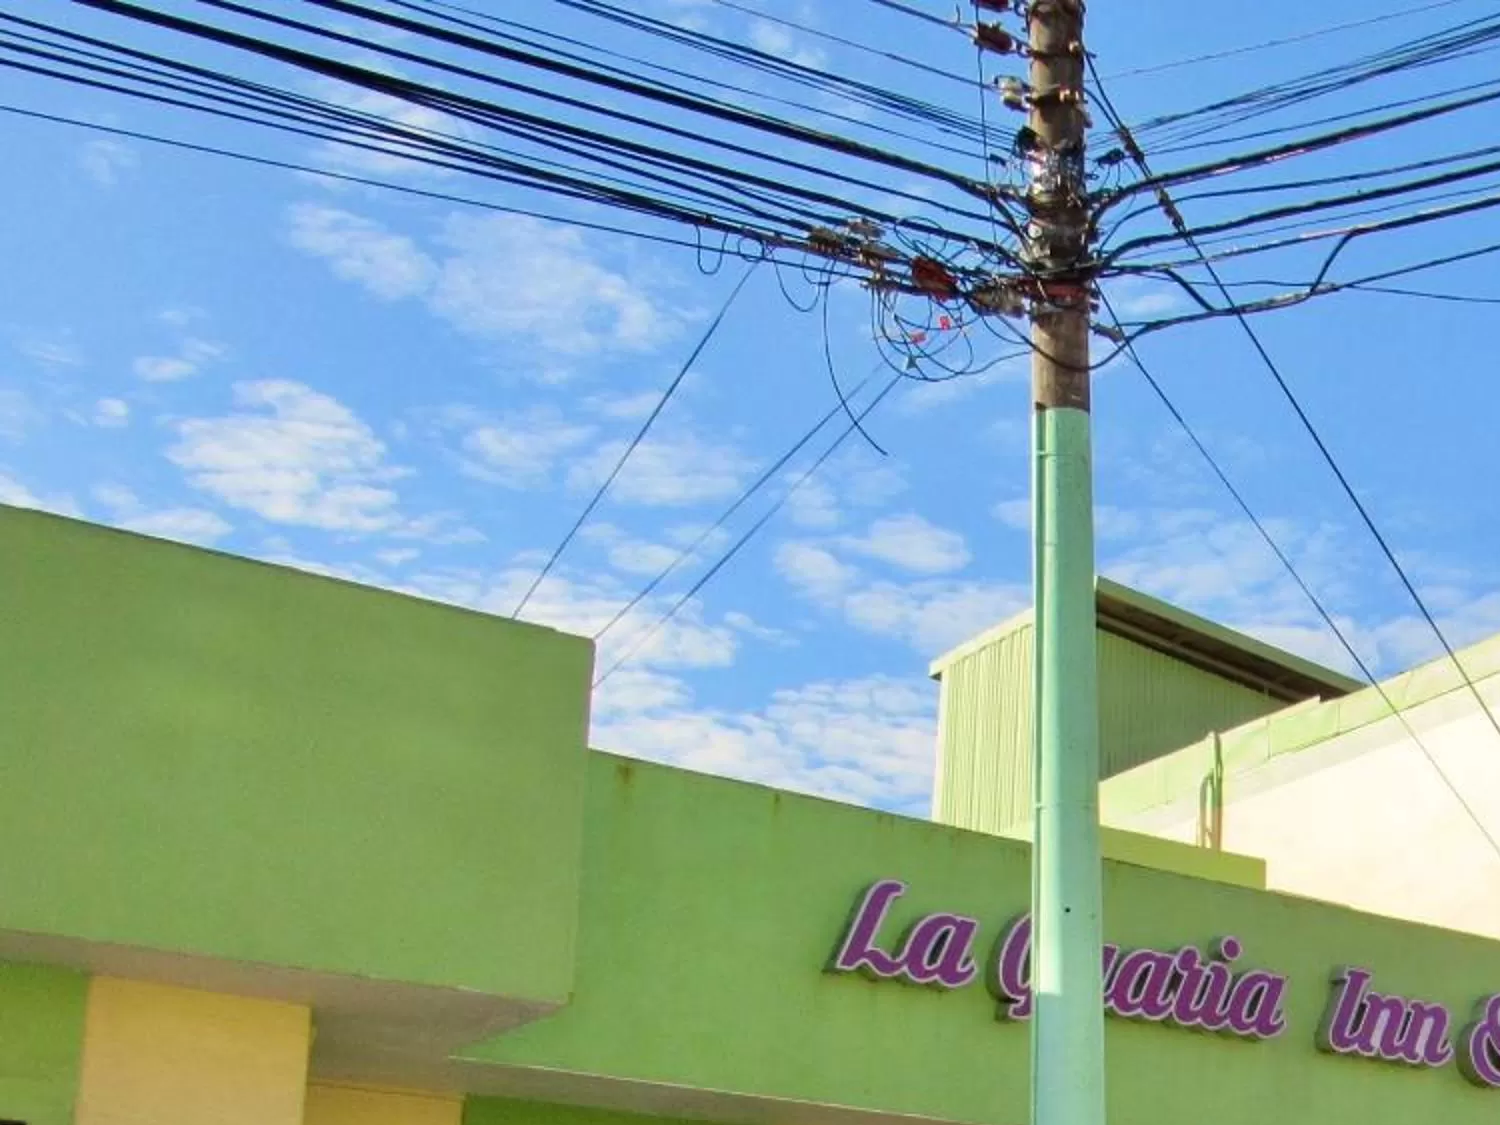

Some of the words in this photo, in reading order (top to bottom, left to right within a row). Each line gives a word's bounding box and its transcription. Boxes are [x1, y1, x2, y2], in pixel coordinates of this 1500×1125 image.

[833, 879, 978, 988] La
[996, 910, 1289, 1039] Garia
[1328, 966, 1454, 1068] Inn
